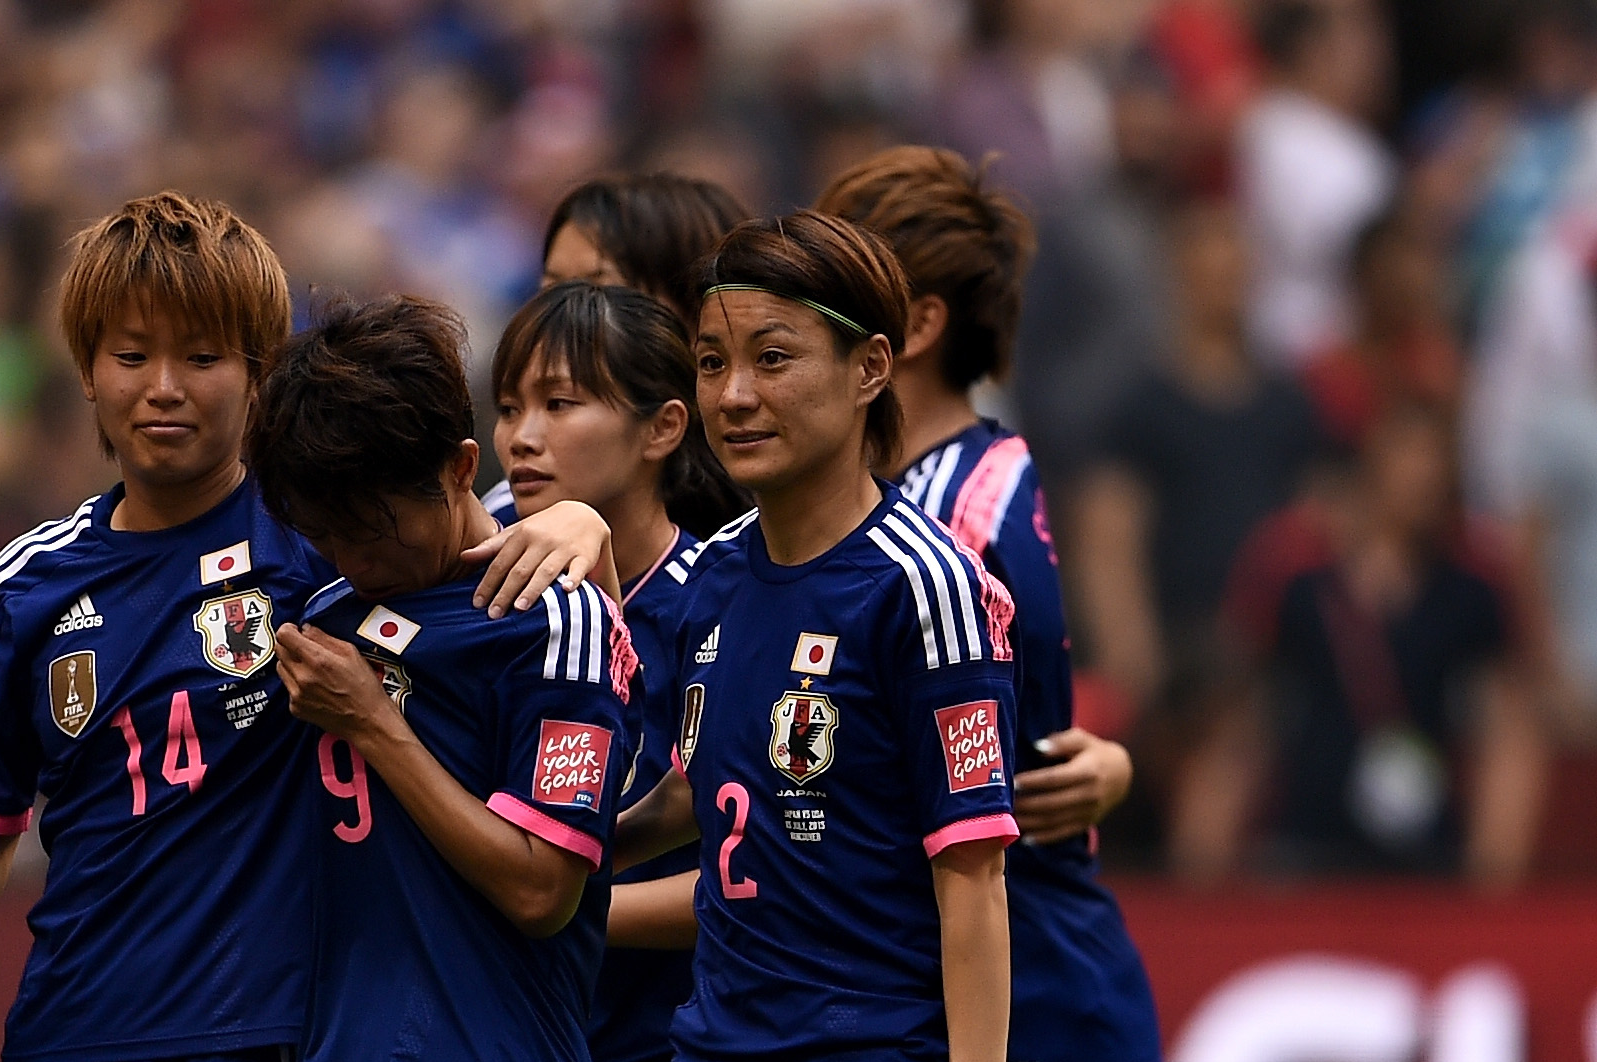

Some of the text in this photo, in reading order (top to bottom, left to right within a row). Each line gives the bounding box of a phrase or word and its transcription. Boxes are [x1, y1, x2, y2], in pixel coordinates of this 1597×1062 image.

[209, 601, 261, 622] JFA
[54, 615, 103, 635] adidas
[783, 703, 826, 720] JFA
[948, 708, 988, 741] LIVE
[110, 690, 207, 815] 14
[545, 732, 591, 753] LIVE
[949, 726, 997, 761] YOUR
[543, 750, 599, 774] YOUR
[540, 768, 601, 795] GOALS
[776, 790, 826, 798] JAPAN
[716, 782, 757, 899] 2
